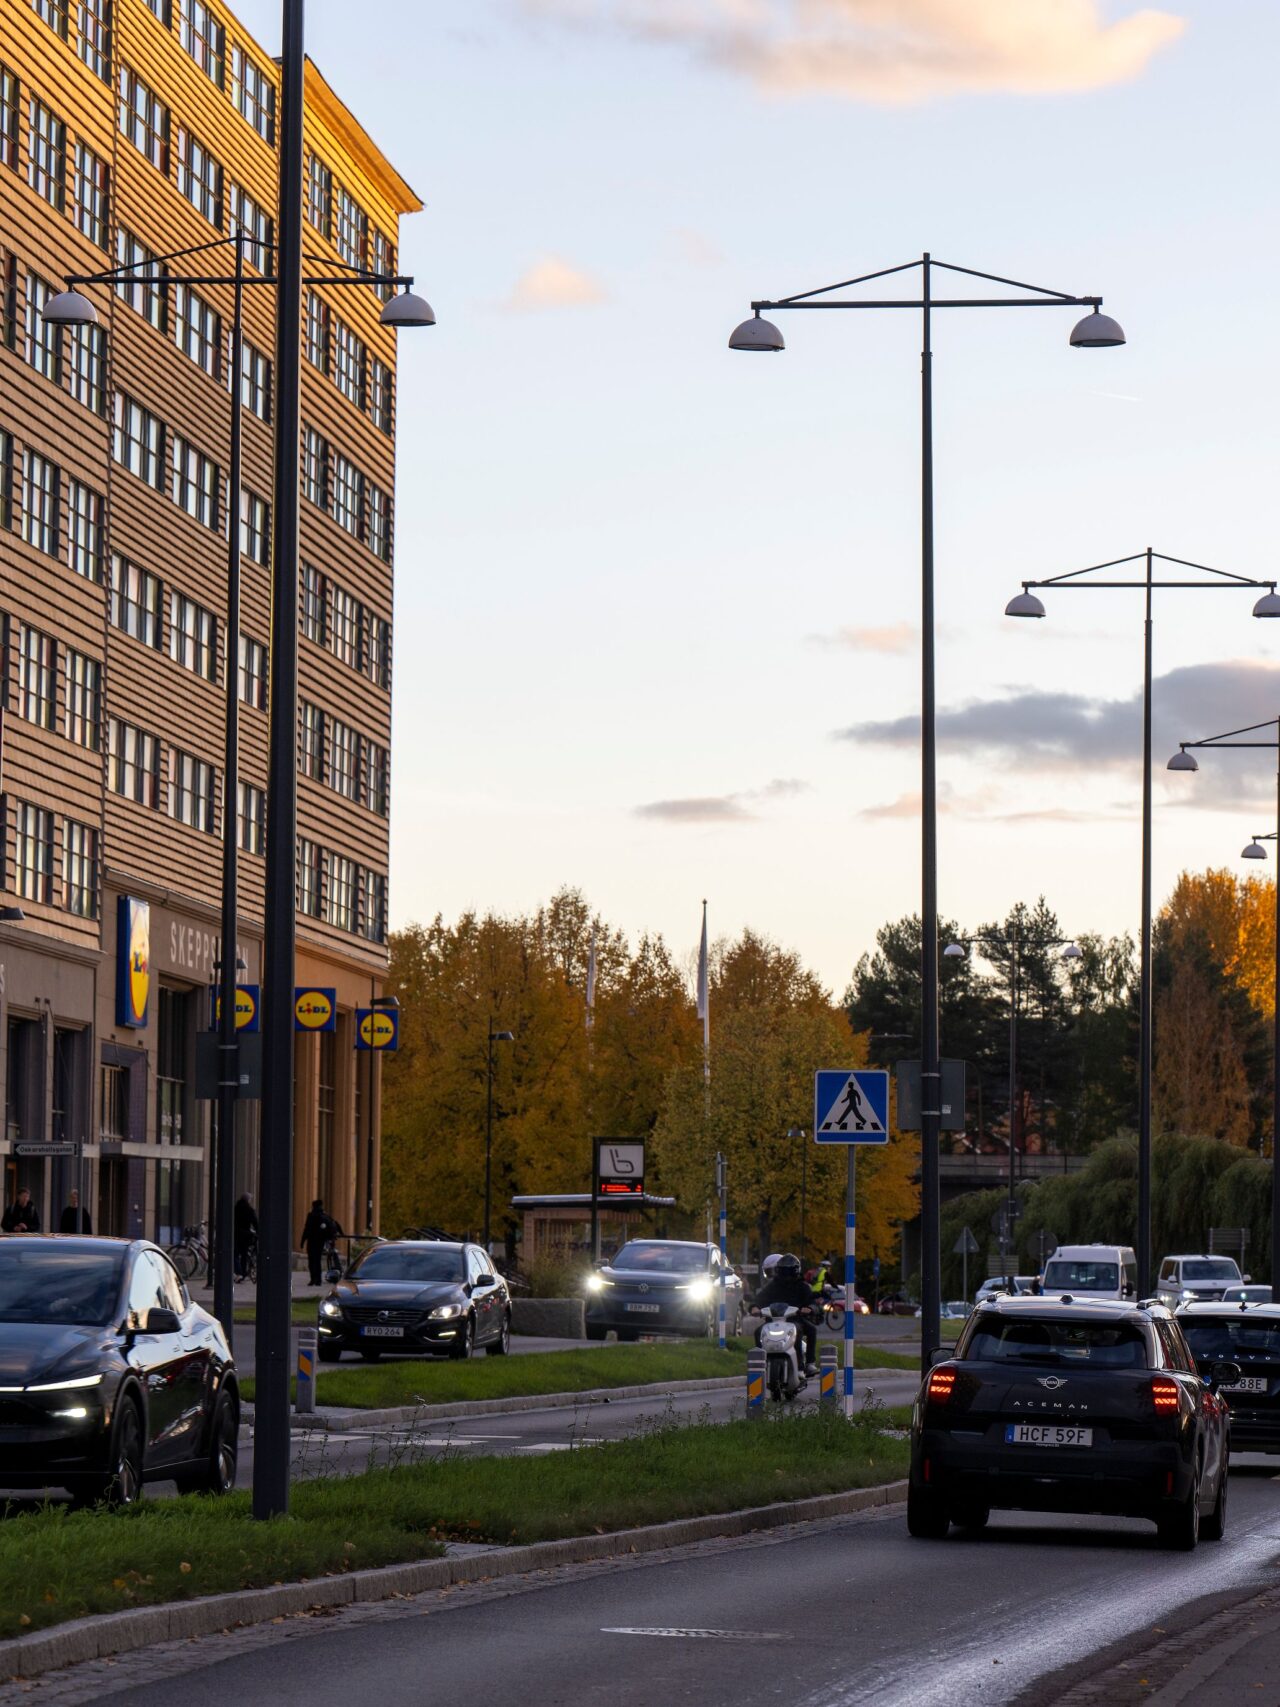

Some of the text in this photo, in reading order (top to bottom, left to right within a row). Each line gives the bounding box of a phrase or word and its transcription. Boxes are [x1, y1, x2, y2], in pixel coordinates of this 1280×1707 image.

[1201, 1353, 1271, 1361] VOLVO
[1240, 1379, 1262, 1389] 88E
[1013, 1401, 1088, 1410] ACEMAN
[1020, 1427, 1086, 1443] HCF 59F
